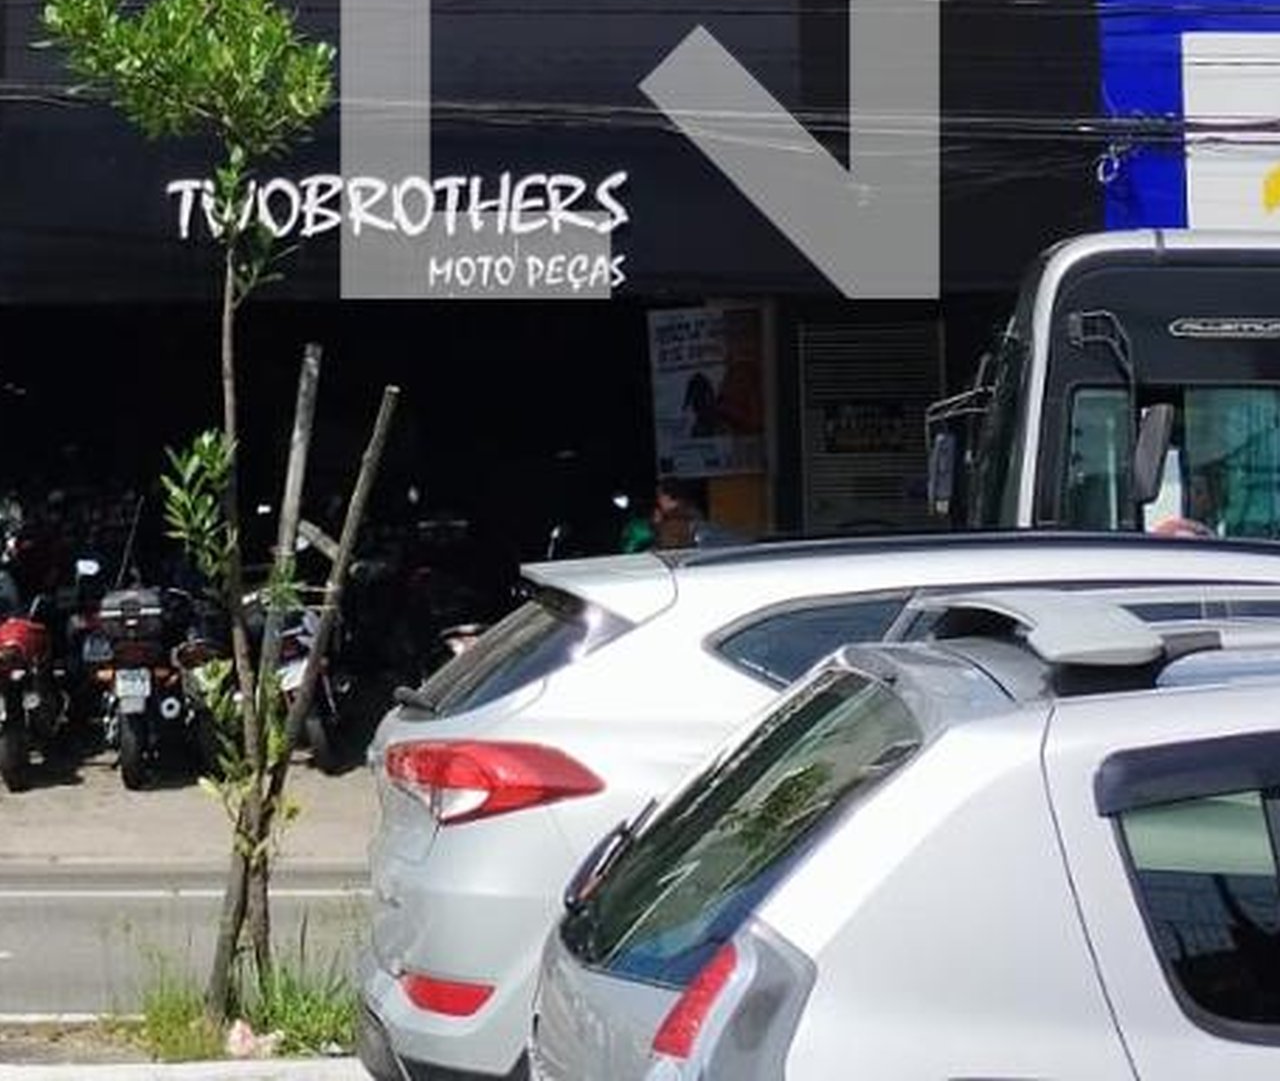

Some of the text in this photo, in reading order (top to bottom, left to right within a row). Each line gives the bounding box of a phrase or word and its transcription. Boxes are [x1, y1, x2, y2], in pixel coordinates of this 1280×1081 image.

[166, 172, 629, 239] TWOBROTHERS
[428, 253, 627, 291] MOTO PEÇAS
